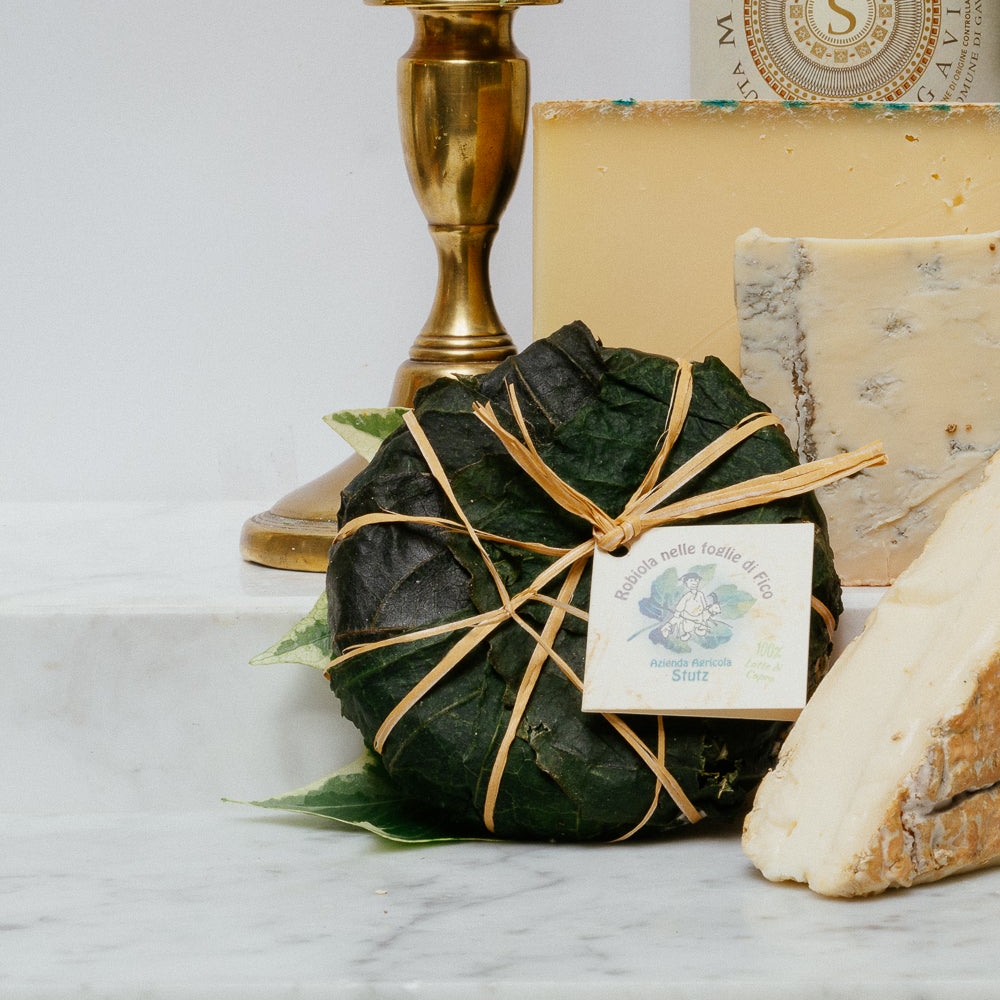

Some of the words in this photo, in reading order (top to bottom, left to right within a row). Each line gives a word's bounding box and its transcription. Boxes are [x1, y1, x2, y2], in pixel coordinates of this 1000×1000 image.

[973, 31, 982, 47] DI
[917, 7, 961, 102] GAVI
[953, 49, 968, 81] ORIGINE
[614, 556, 658, 601] Robiola
[660, 543, 696, 561] nelle
[701, 541, 742, 564] foglie
[742, 558, 757, 574] di
[753, 570, 774, 600] Fico
[650, 658, 689, 668] Azienda
[691, 658, 732, 669] Agricola
[671, 669, 709, 682] Stutz
